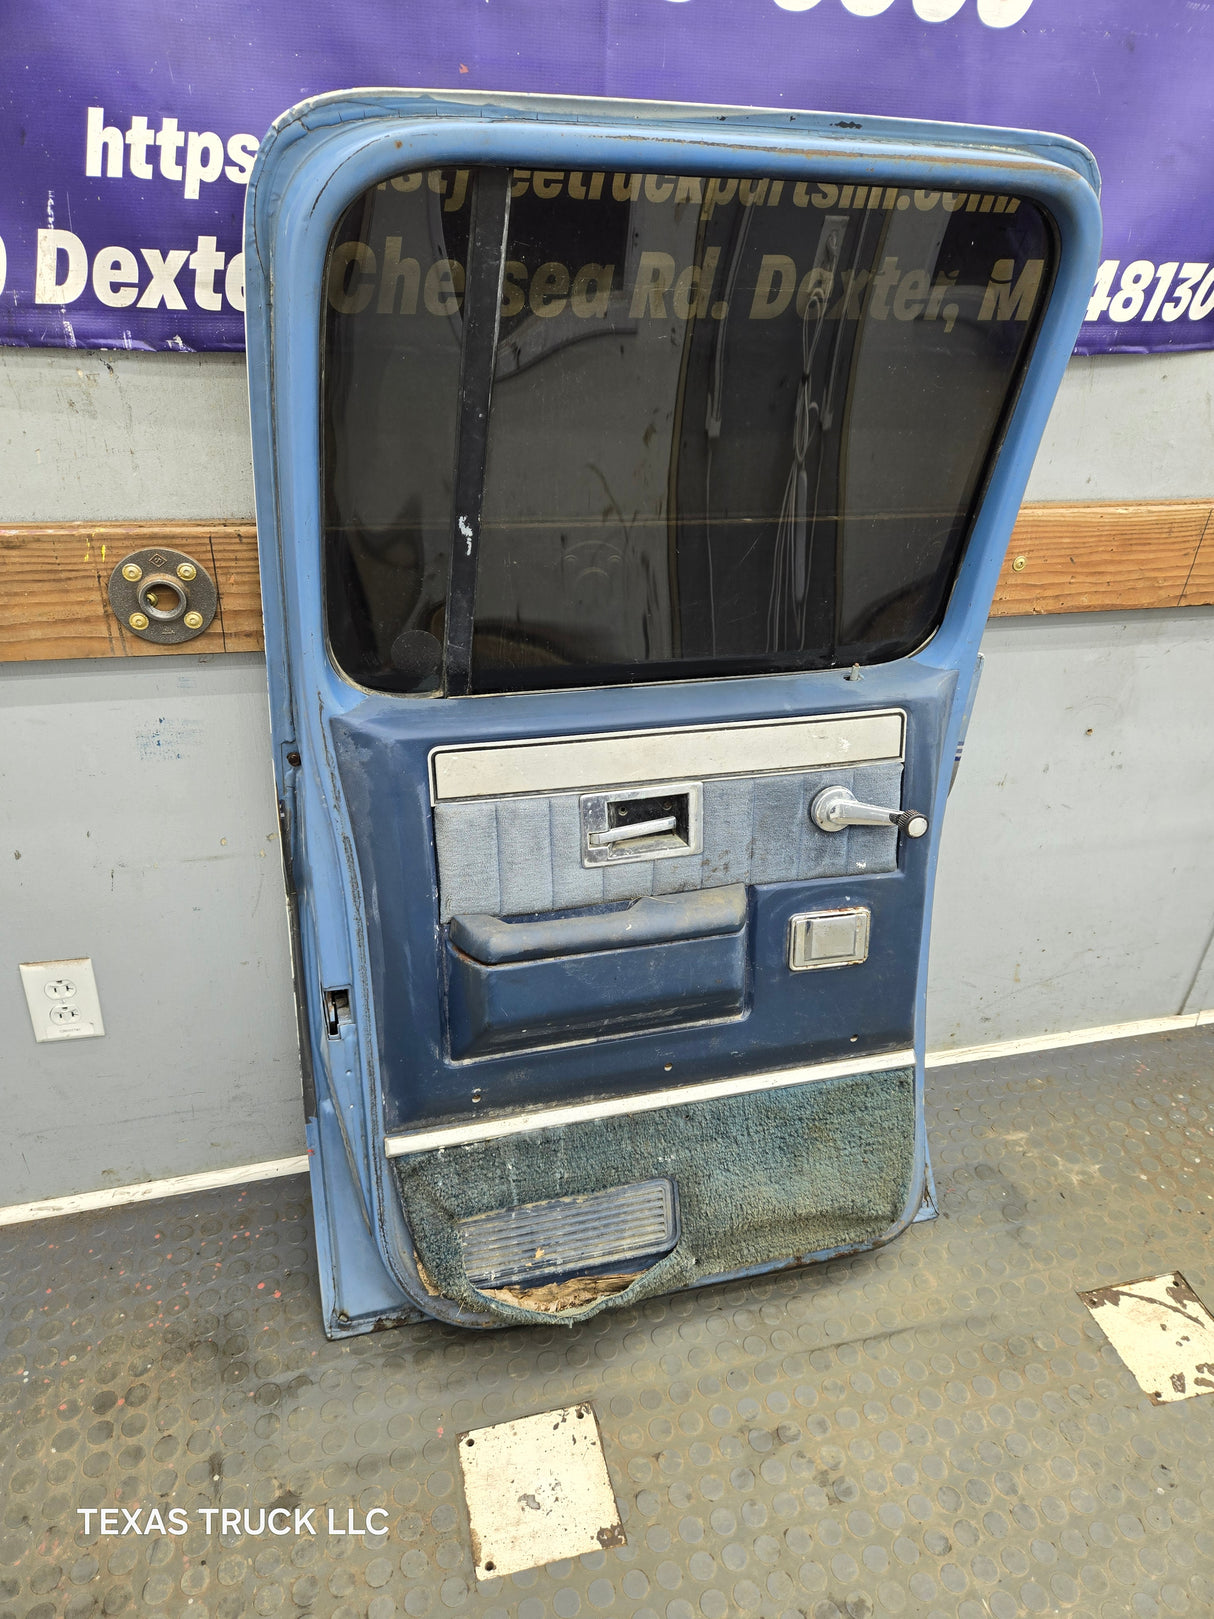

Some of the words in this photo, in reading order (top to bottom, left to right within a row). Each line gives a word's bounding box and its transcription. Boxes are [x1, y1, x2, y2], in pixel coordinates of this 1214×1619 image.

[86, 107, 260, 199] https
[327, 236, 615, 318] Chesea
[629, 247, 729, 319] Rd.
[749, 254, 959, 333] Dexter,
[1084, 260, 1214, 322] 48130
